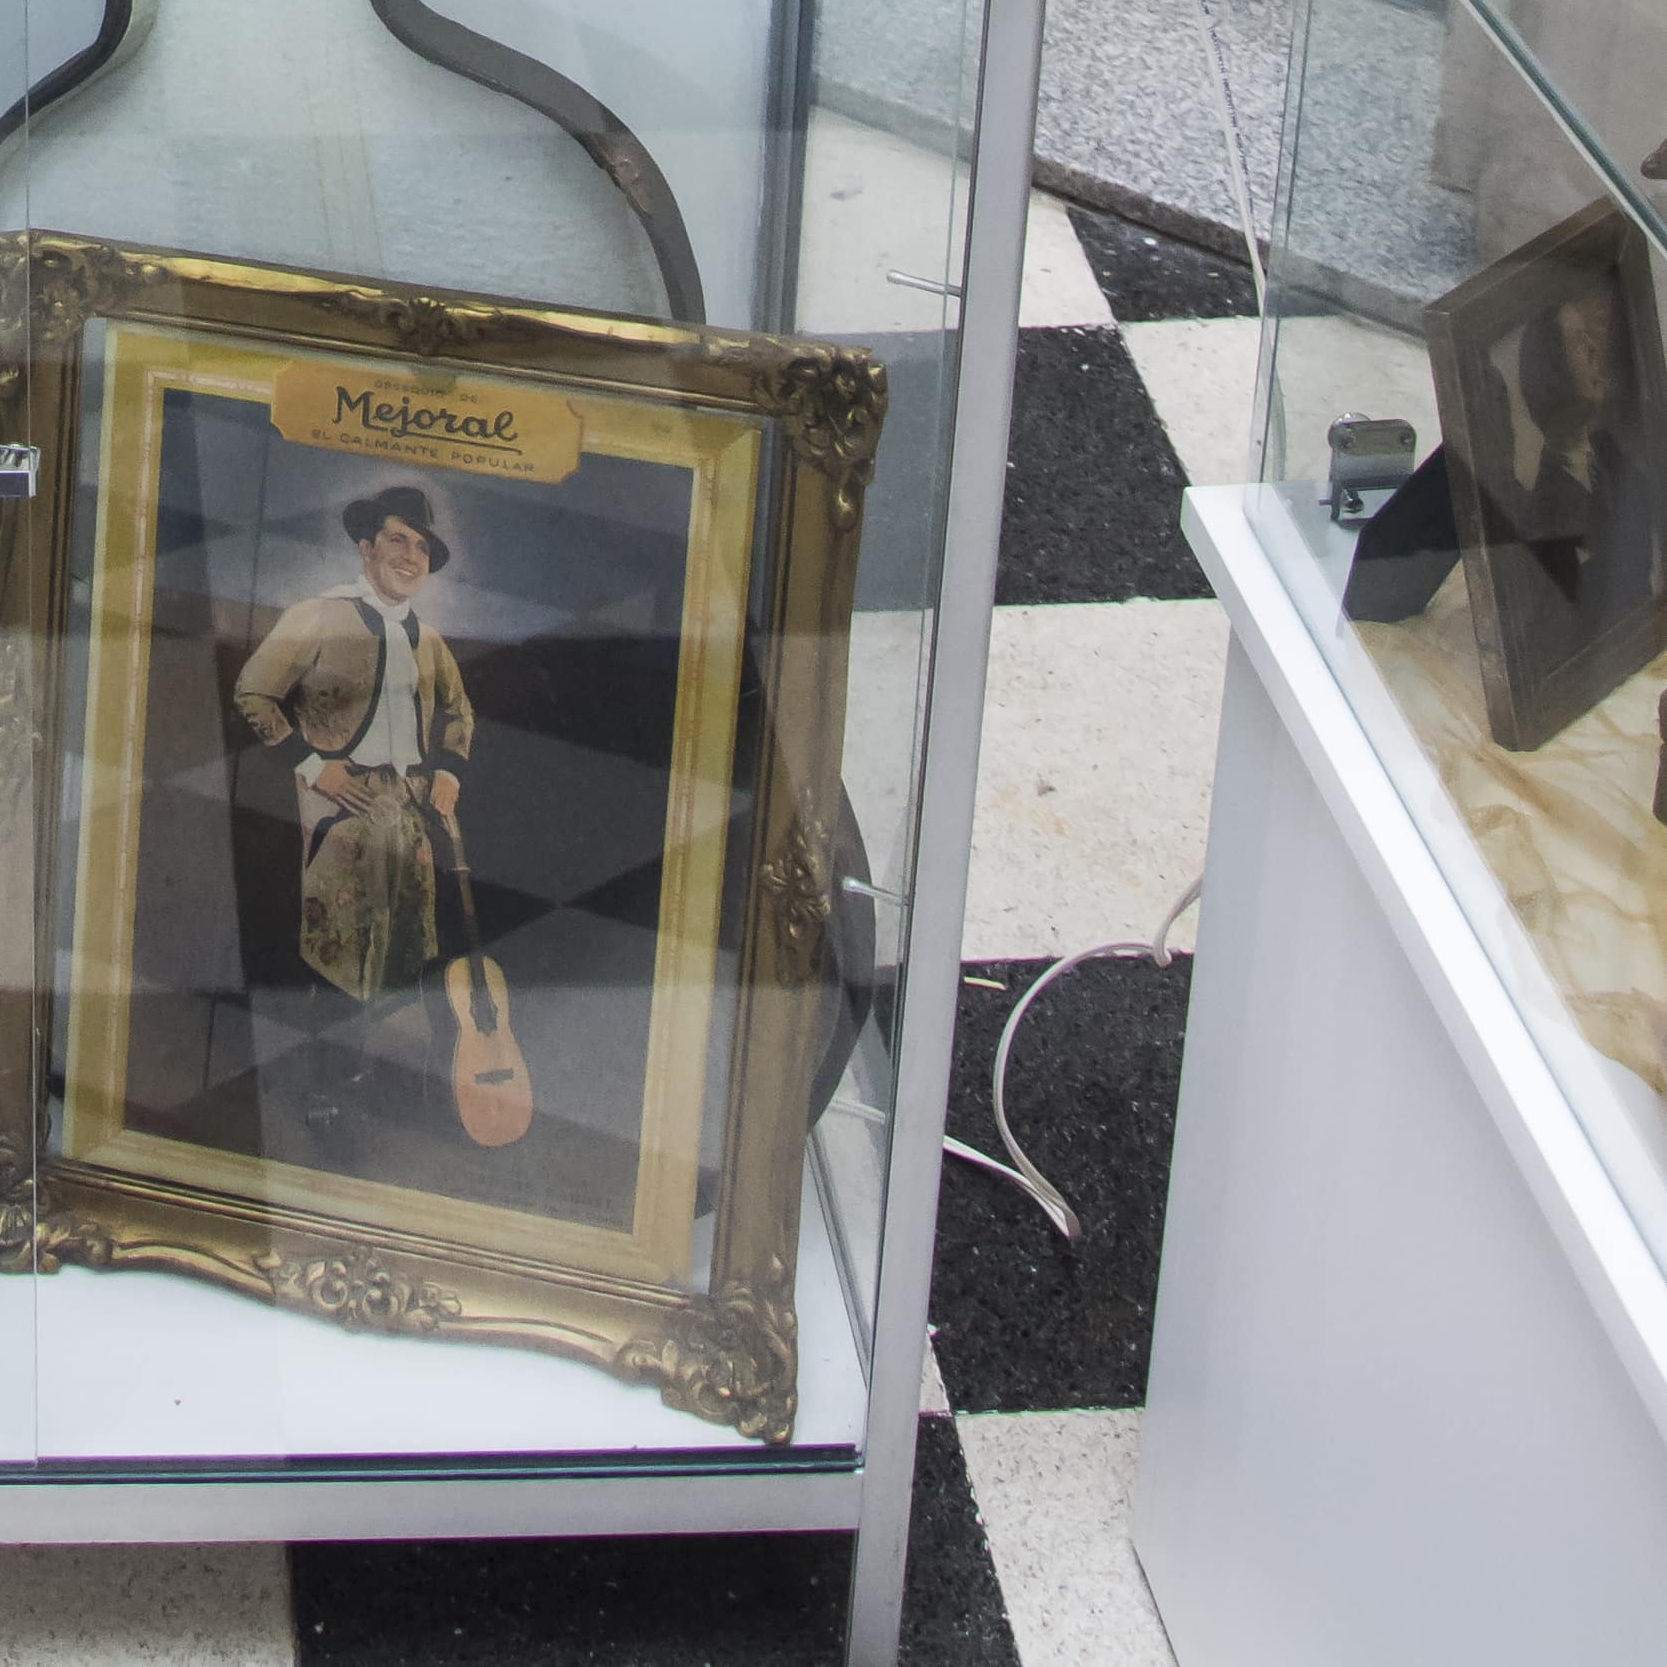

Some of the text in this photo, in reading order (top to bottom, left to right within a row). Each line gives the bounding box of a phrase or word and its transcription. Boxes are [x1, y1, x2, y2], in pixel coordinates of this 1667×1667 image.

[332, 385, 519, 442] Mejoral
[339, 432, 439, 459] CALMANTE
[450, 449, 536, 472] POPULAR
